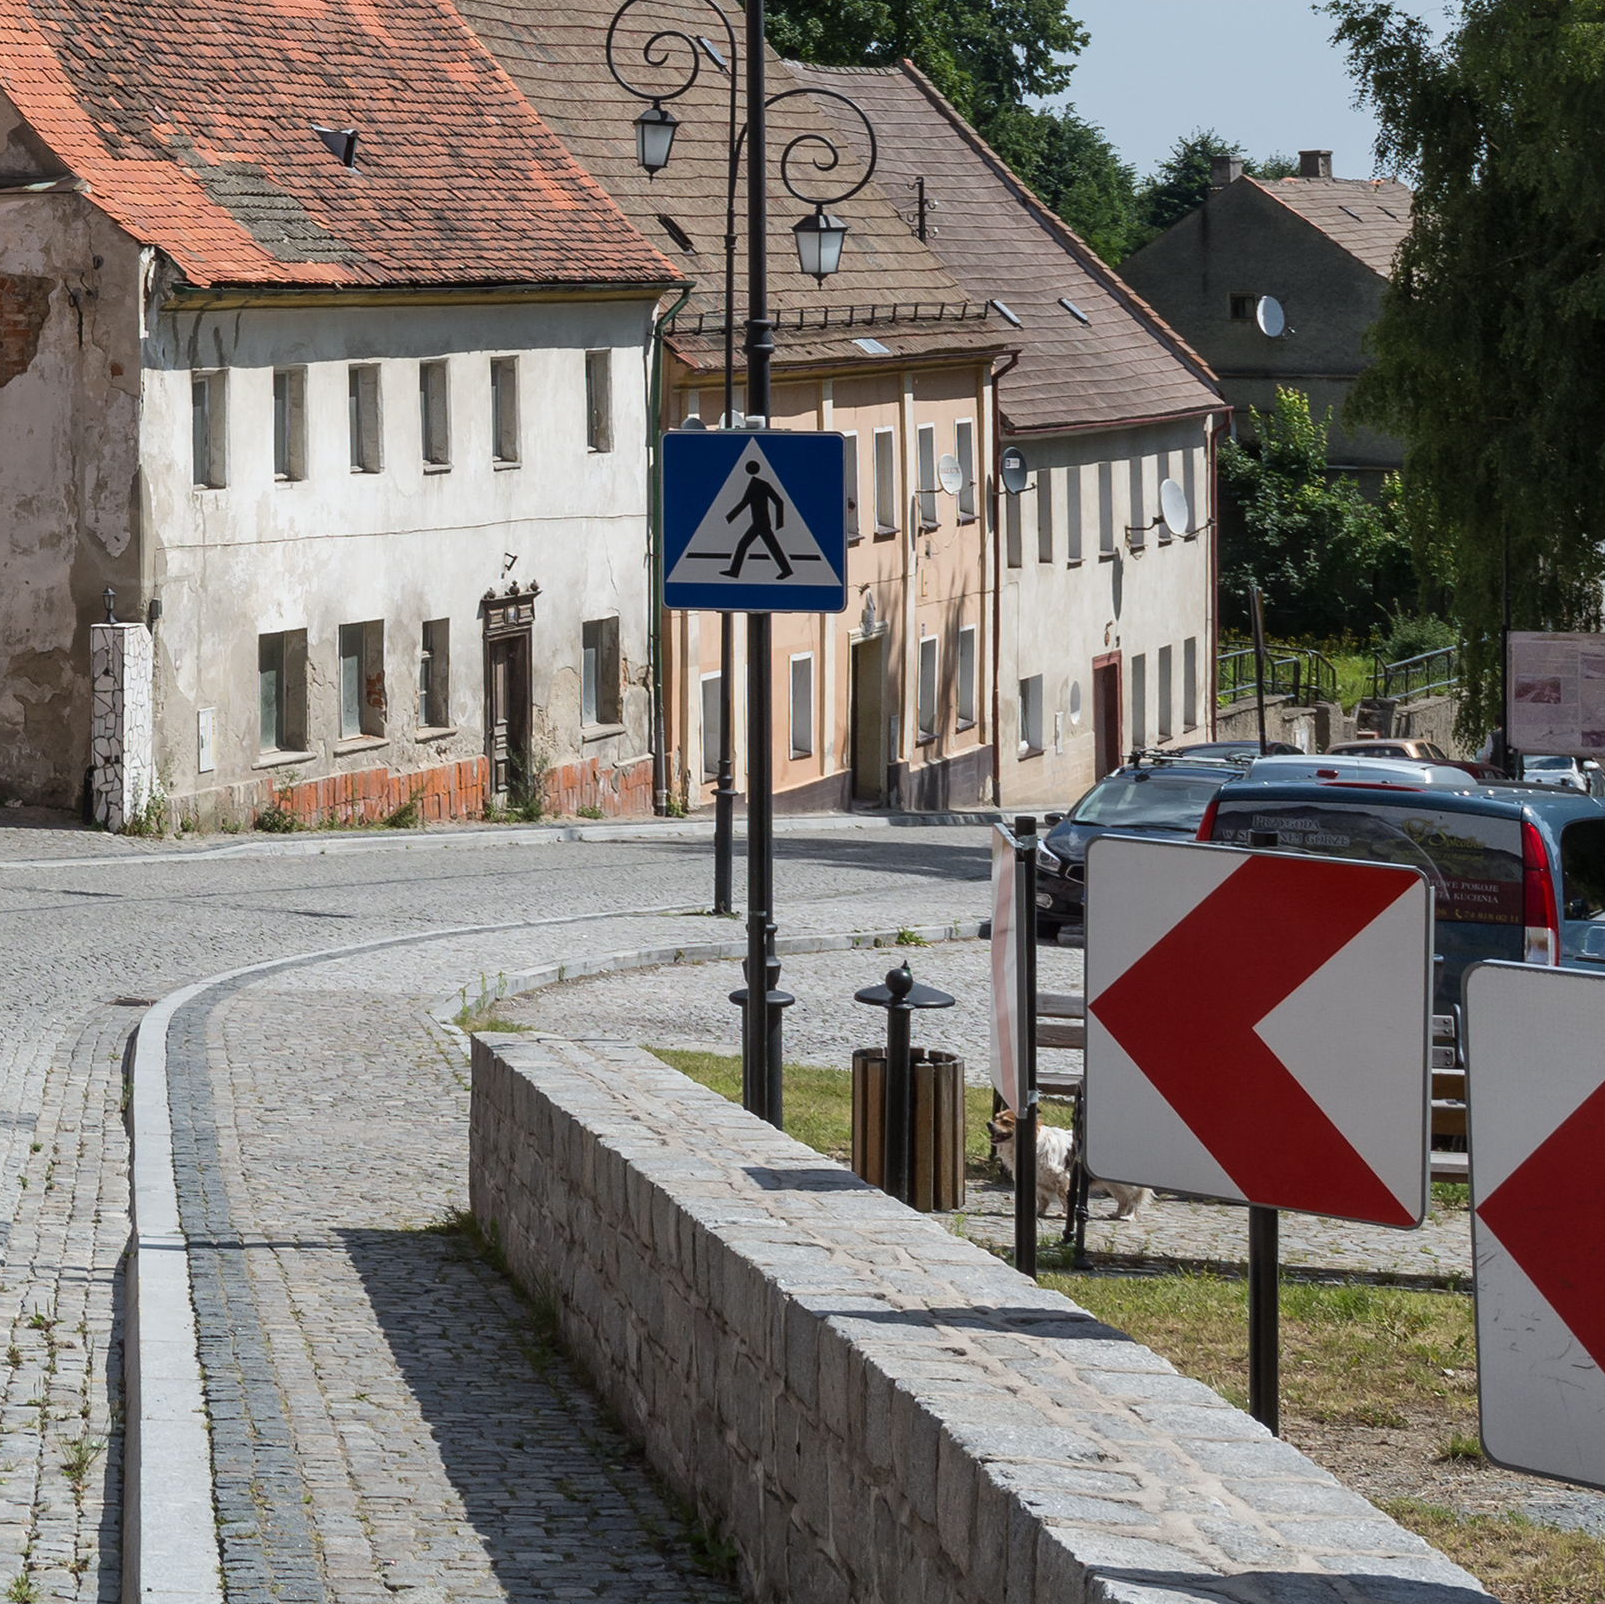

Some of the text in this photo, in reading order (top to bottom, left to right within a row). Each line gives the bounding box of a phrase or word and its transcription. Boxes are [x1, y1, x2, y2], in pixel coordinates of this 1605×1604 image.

[1252, 814, 1322, 830] PRZYGODA
[1461, 881, 1500, 893] POKOJE
[1453, 892, 1499, 904] KUCHNIA
